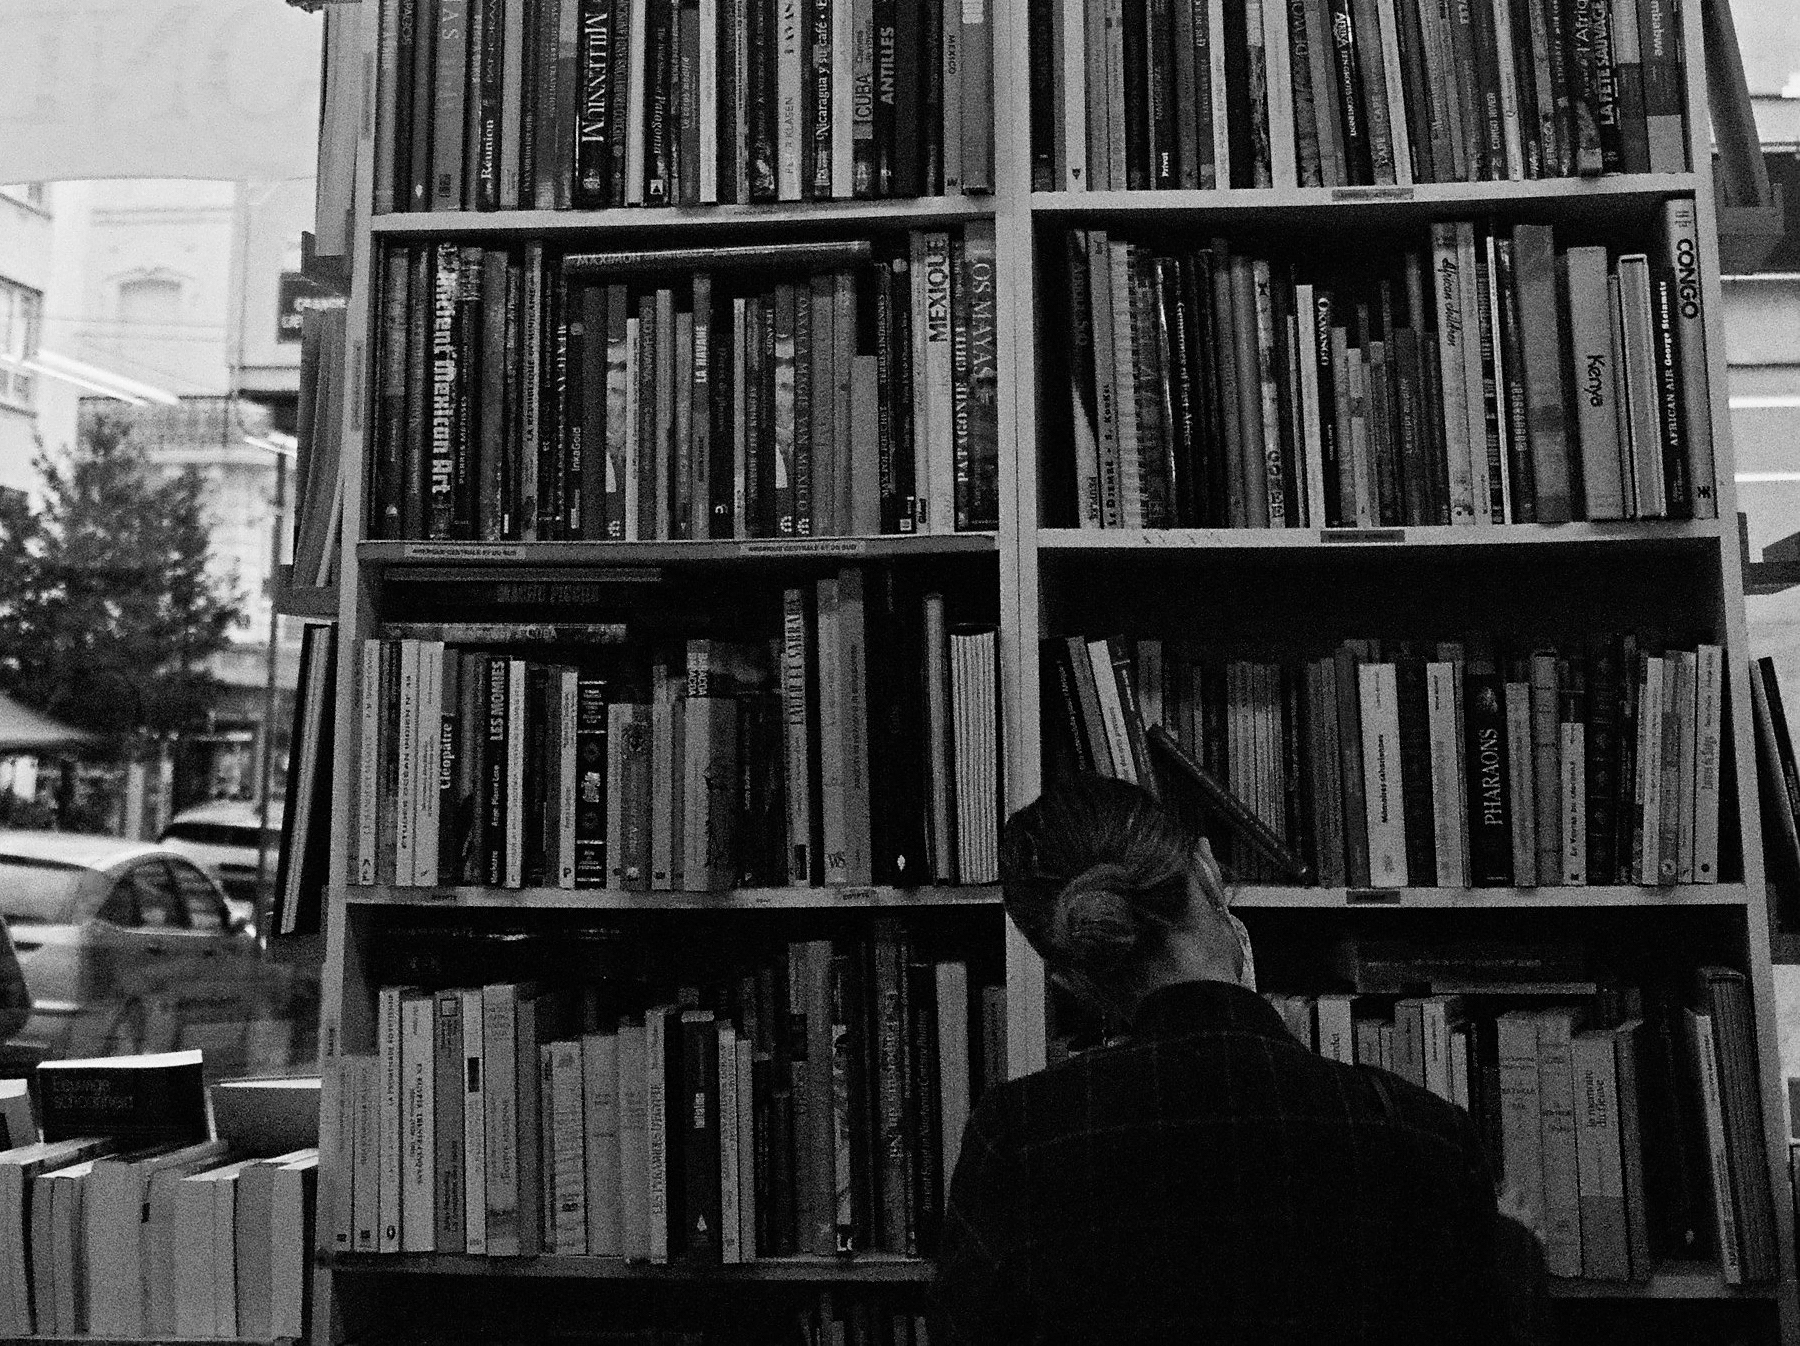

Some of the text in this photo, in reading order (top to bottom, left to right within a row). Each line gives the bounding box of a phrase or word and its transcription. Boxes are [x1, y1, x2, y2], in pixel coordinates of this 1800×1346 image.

[814, 22, 828, 47] café
[817, 50, 828, 63] su
[947, 34, 956, 75] MEXICO
[1591, 0, 1610, 66] SAUVAGE
[581, 12, 608, 143] MILLENNIUM
[879, 26, 895, 105] ANTILLES
[651, 95, 667, 154] Patagonia
[783, 97, 794, 139] KLASEN
[814, 77, 830, 140] Nicaragua
[854, 73, 872, 118] CUBA
[1345, 95, 1357, 137] CONTINENT
[1371, 94, 1384, 123] CAPE
[1486, 92, 1501, 150] CONGO RIVER
[1599, 104, 1615, 125] LA
[480, 119, 494, 180] Réunion
[926, 237, 949, 342] MEXIQUE
[1437, 257, 1461, 347] African children
[1676, 238, 1700, 319] CONGO
[766, 308, 774, 356] LES ANDES
[876, 293, 887, 385] TERRES INDIENNES
[970, 248, 993, 378] LOS MAYAS
[695, 325, 707, 383] LA HAVANE
[1661, 332, 1673, 367] George
[796, 296, 808, 512] OAXACA MAGIE VAN MEXICO
[1583, 354, 1605, 407] Kenya
[1665, 368, 1676, 391] AIR
[955, 382, 968, 483] PATAGONIE
[1666, 392, 1679, 447] AFRICAN
[431, 459, 453, 494] Art
[489, 660, 505, 741] LES MOMIES
[1478, 728, 1504, 825] PHARAONS
